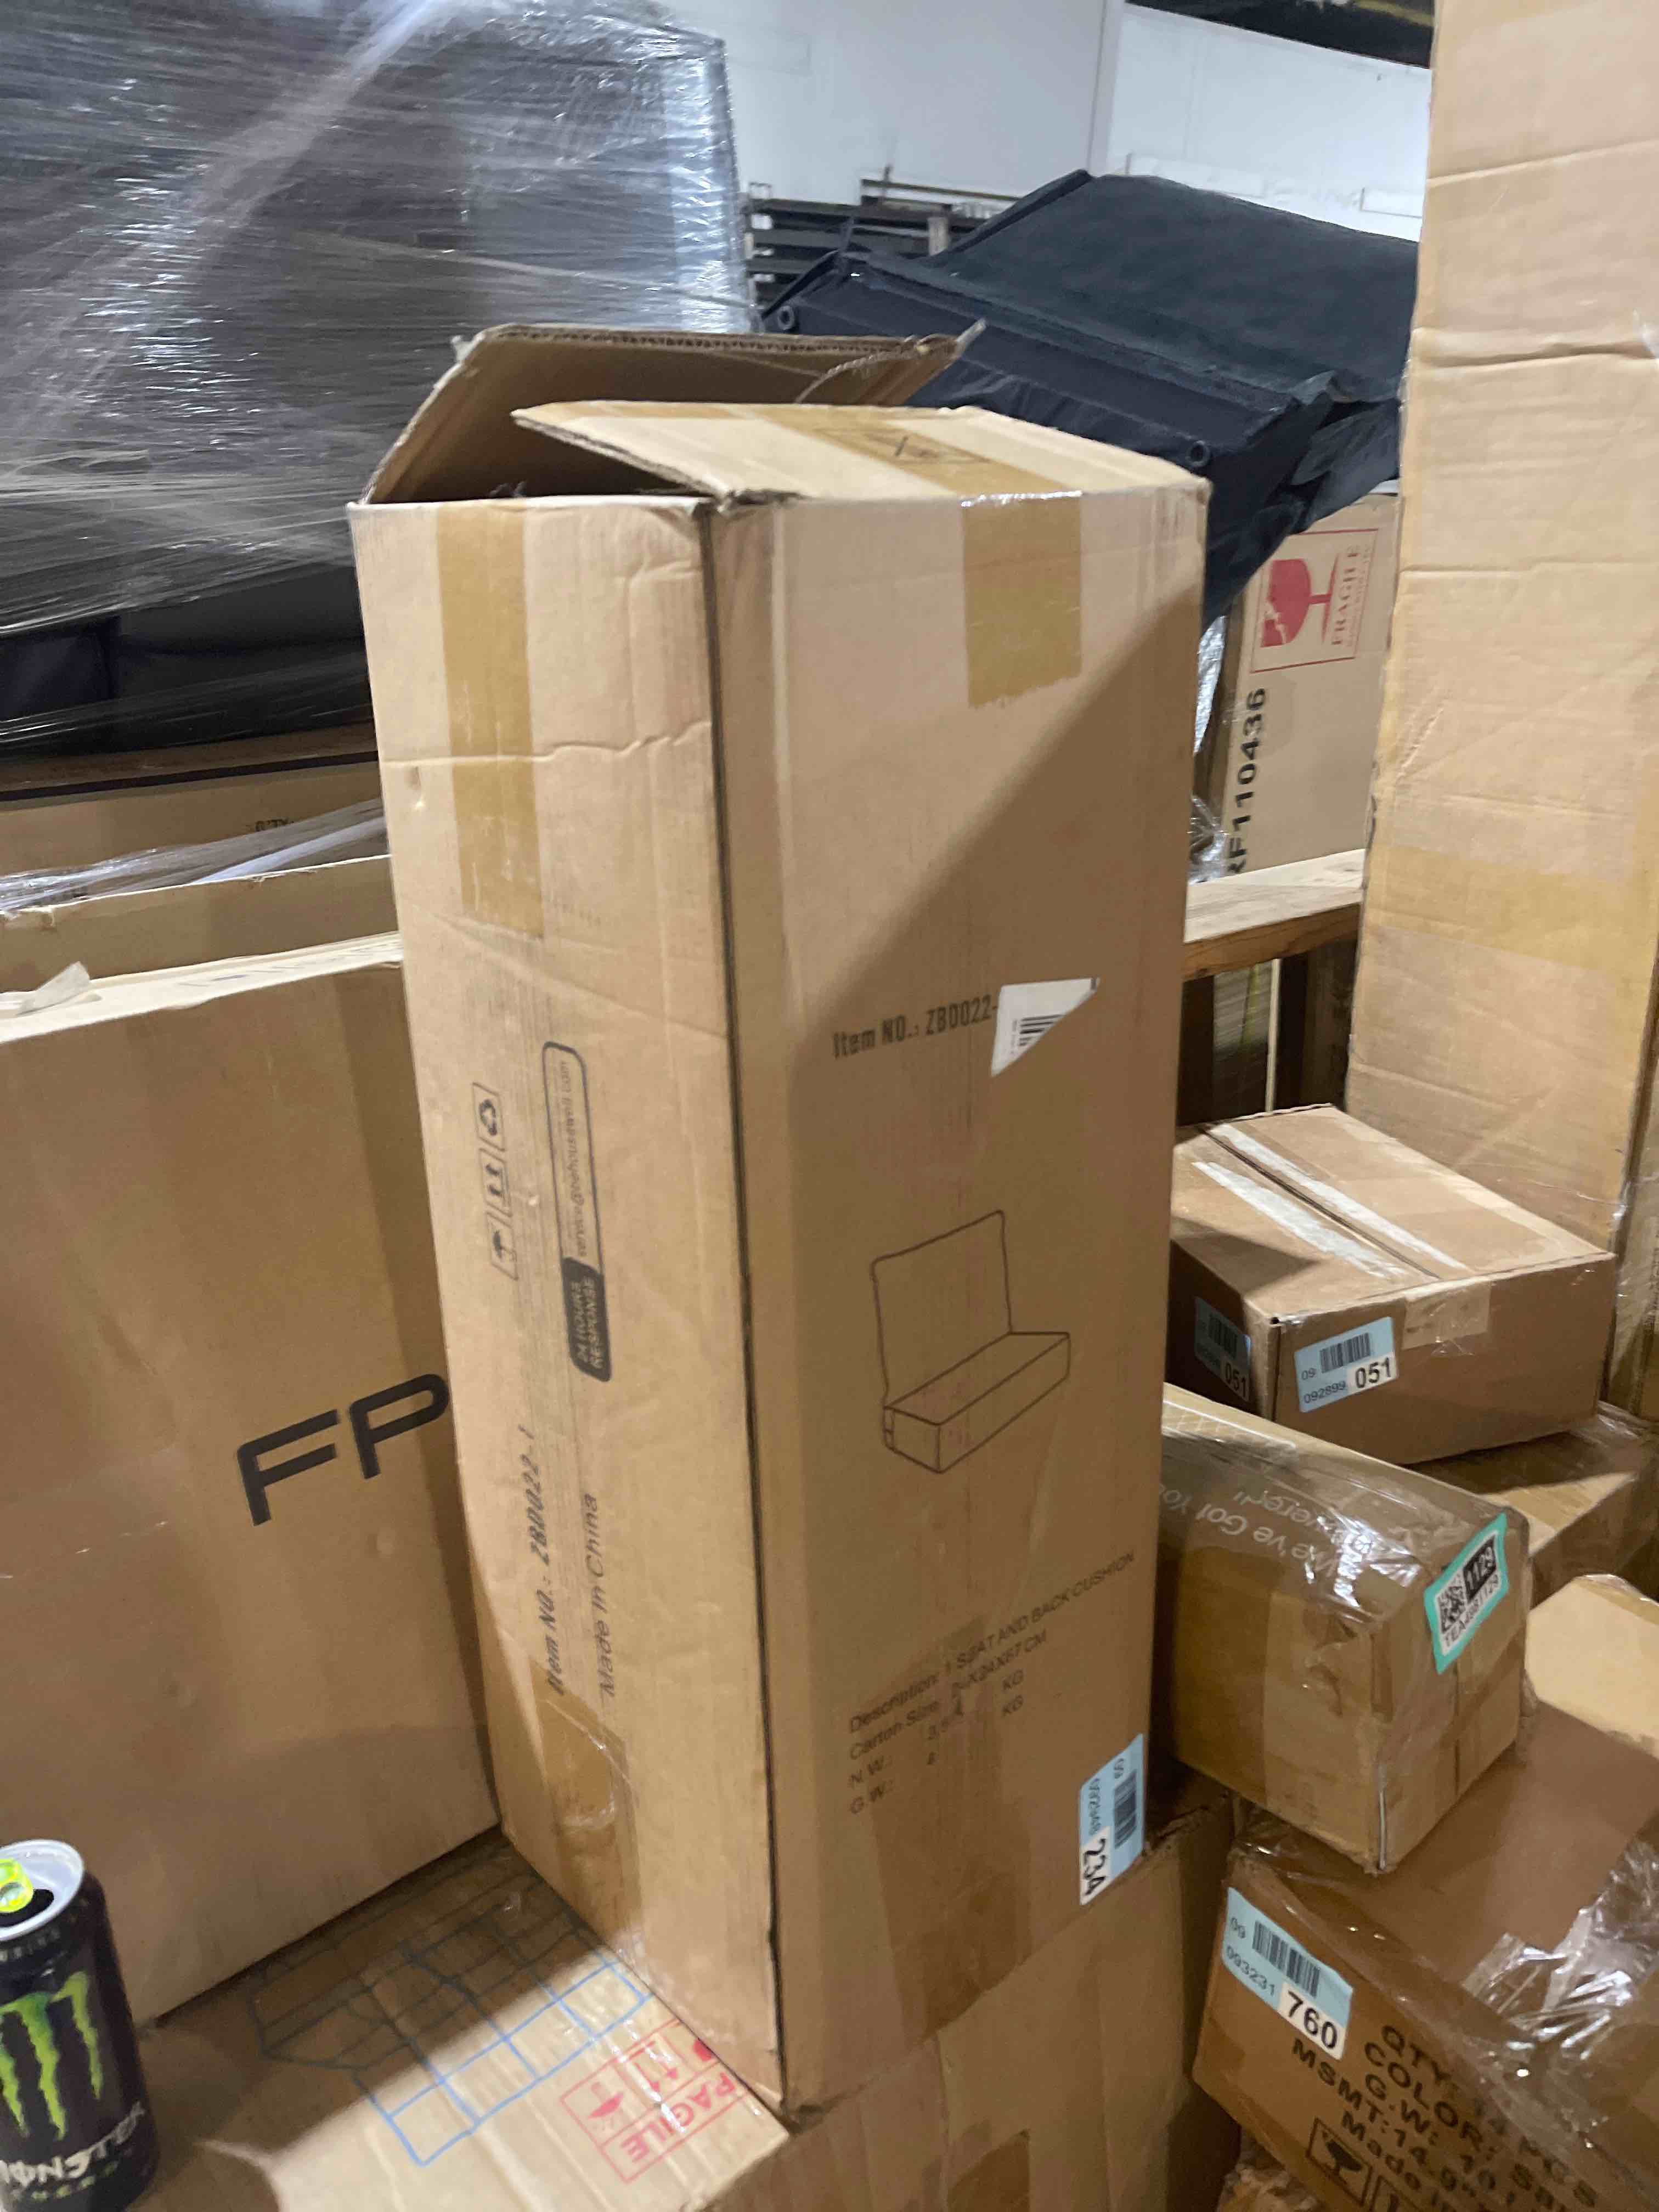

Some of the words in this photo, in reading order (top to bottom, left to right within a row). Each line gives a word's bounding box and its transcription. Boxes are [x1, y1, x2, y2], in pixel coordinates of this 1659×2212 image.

[833, 1027, 877, 1059] Item
[1224, 1361, 1248, 1399] 051
[1354, 1357, 1392, 1389] 051
[580, 1492, 605, 1579] China
[956, 1633, 996, 1669] SEAT
[997, 1615, 1029, 1644] AND
[1030, 1591, 1070, 1624] BACK
[1071, 1552, 1135, 1598] CUSHION
[591, 1618, 616, 1698] Made
[1288, 1990, 1338, 2050] 760
[1364, 2041, 1496, 2162] COLOR:
